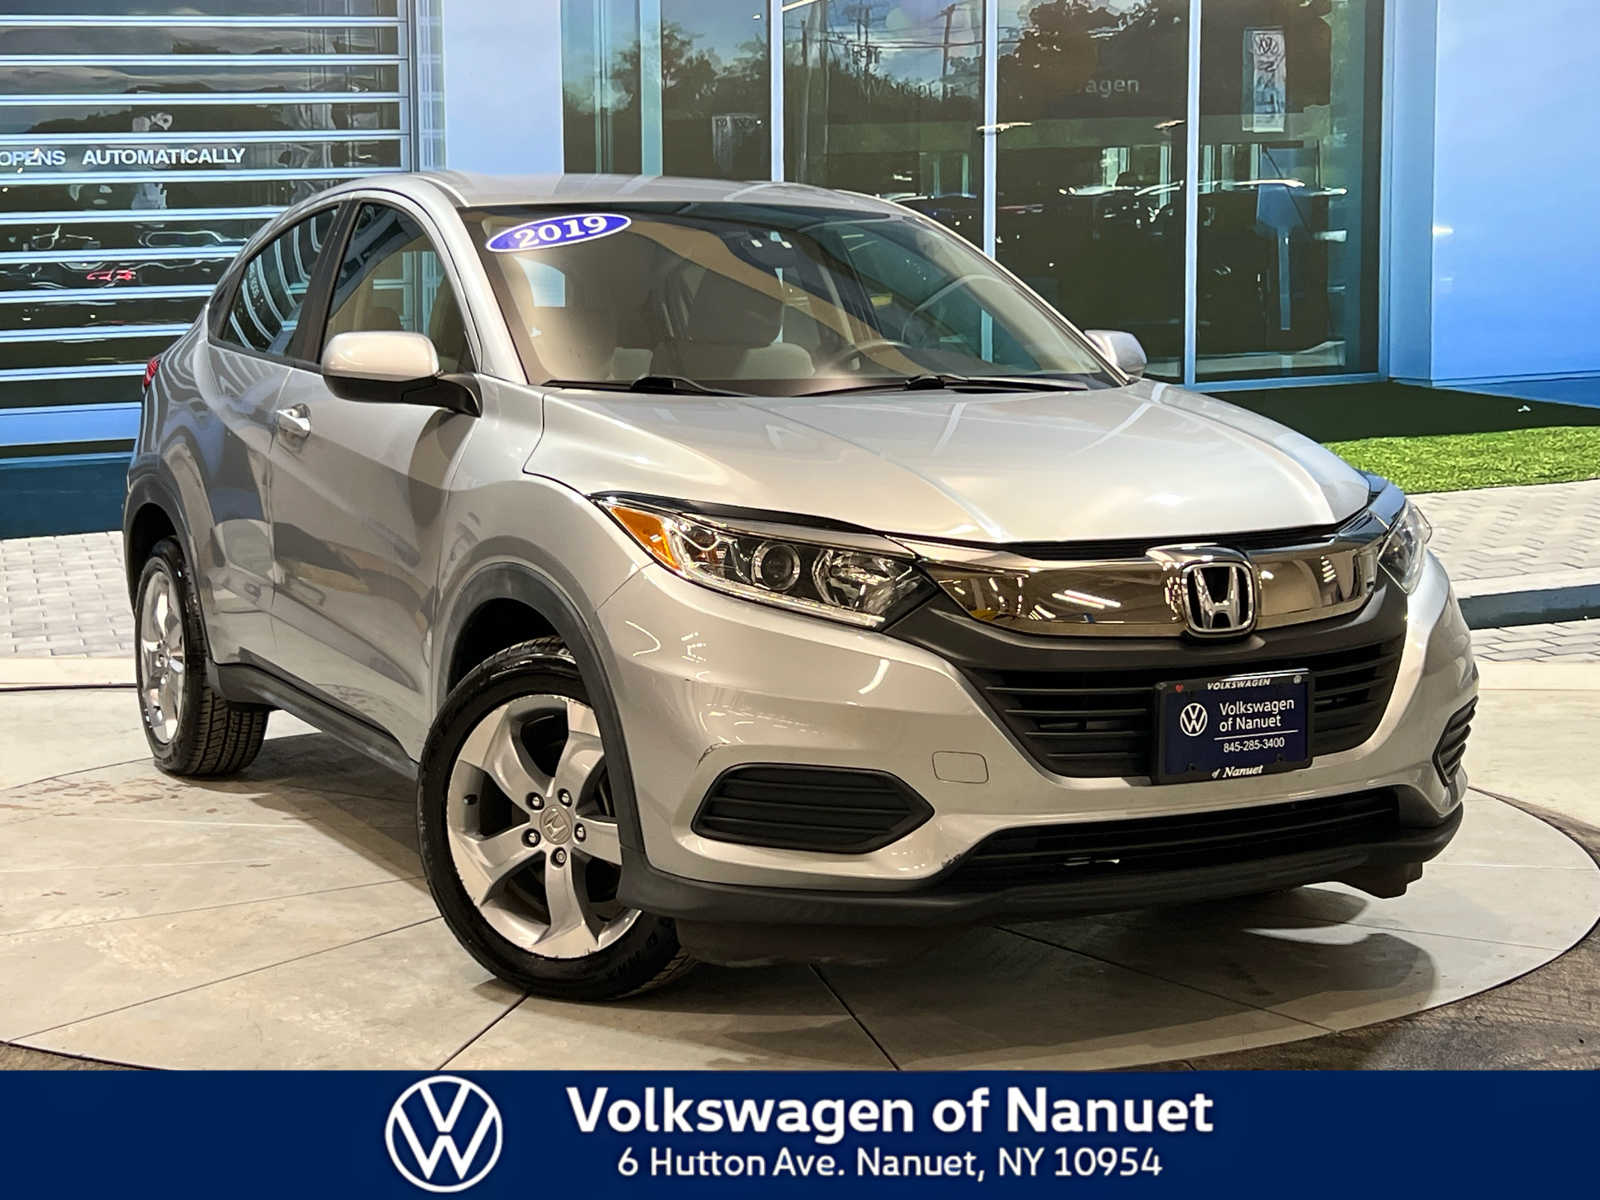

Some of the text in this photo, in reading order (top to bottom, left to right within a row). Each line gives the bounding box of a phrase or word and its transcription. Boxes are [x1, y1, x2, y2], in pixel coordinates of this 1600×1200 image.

[0, 147, 246, 166] OPENS AUTOMATICALLY
[514, 215, 608, 249] 2019
[1207, 677, 1271, 690] VOLKSWAGEN
[1219, 699, 1295, 716] Volkswagen
[1219, 714, 1282, 732] of Nanuet
[1223, 737, 1286, 753] 845-285-3400
[1223, 765, 1264, 778] Nanuet
